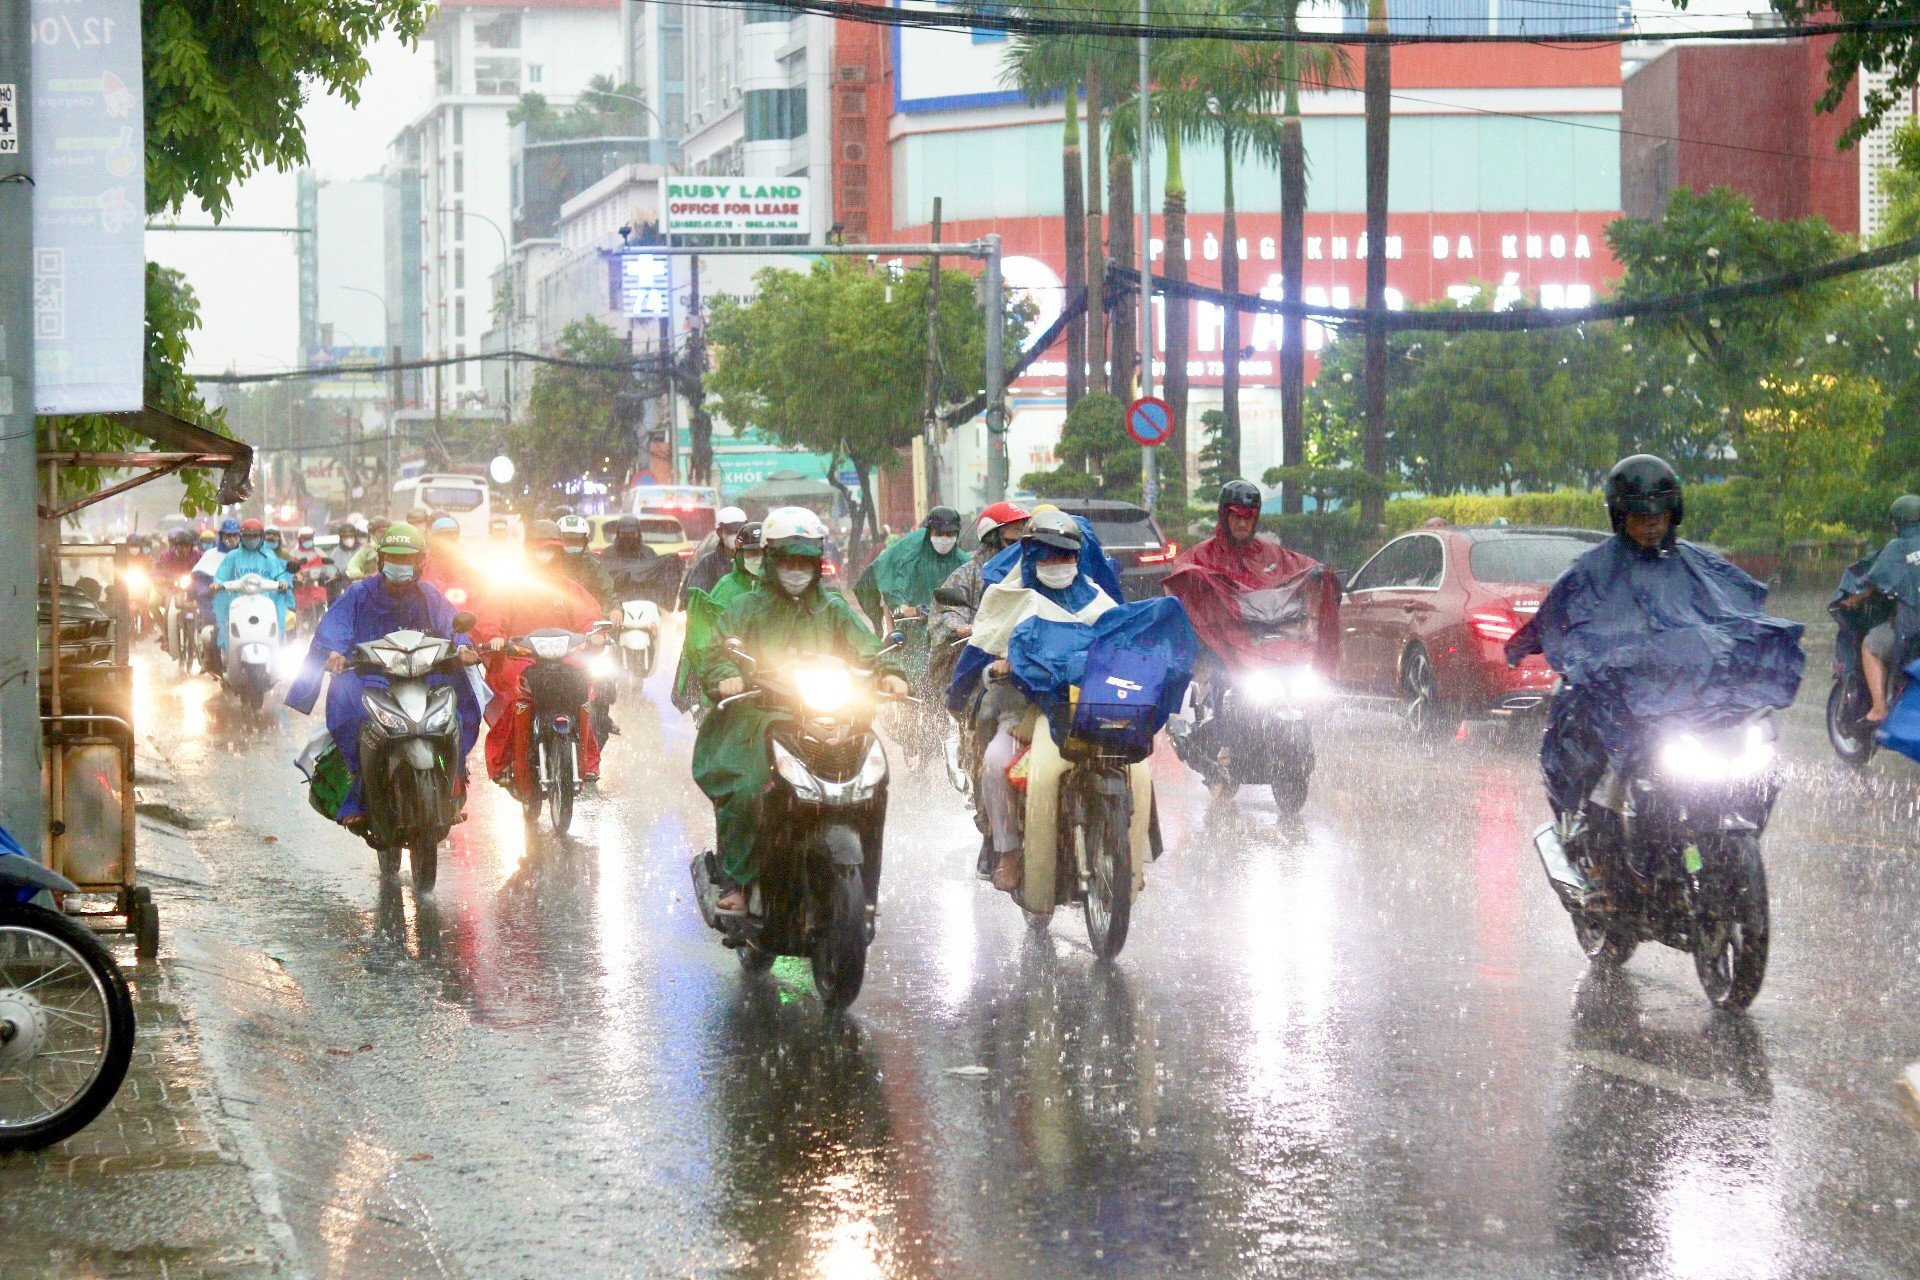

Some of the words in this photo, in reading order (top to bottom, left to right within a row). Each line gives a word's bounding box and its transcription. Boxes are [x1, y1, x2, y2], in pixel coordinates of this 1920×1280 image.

[668, 184, 731, 199] RUBY
[739, 184, 802, 199] LAND
[670, 203, 720, 214] OFFICE
[724, 203, 751, 214] FOR
[755, 203, 799, 215] LEASE
[1432, 235, 1473, 259] ĐA
[1502, 234, 1591, 259] KHOA
[386, 535, 411, 544] GHTK
